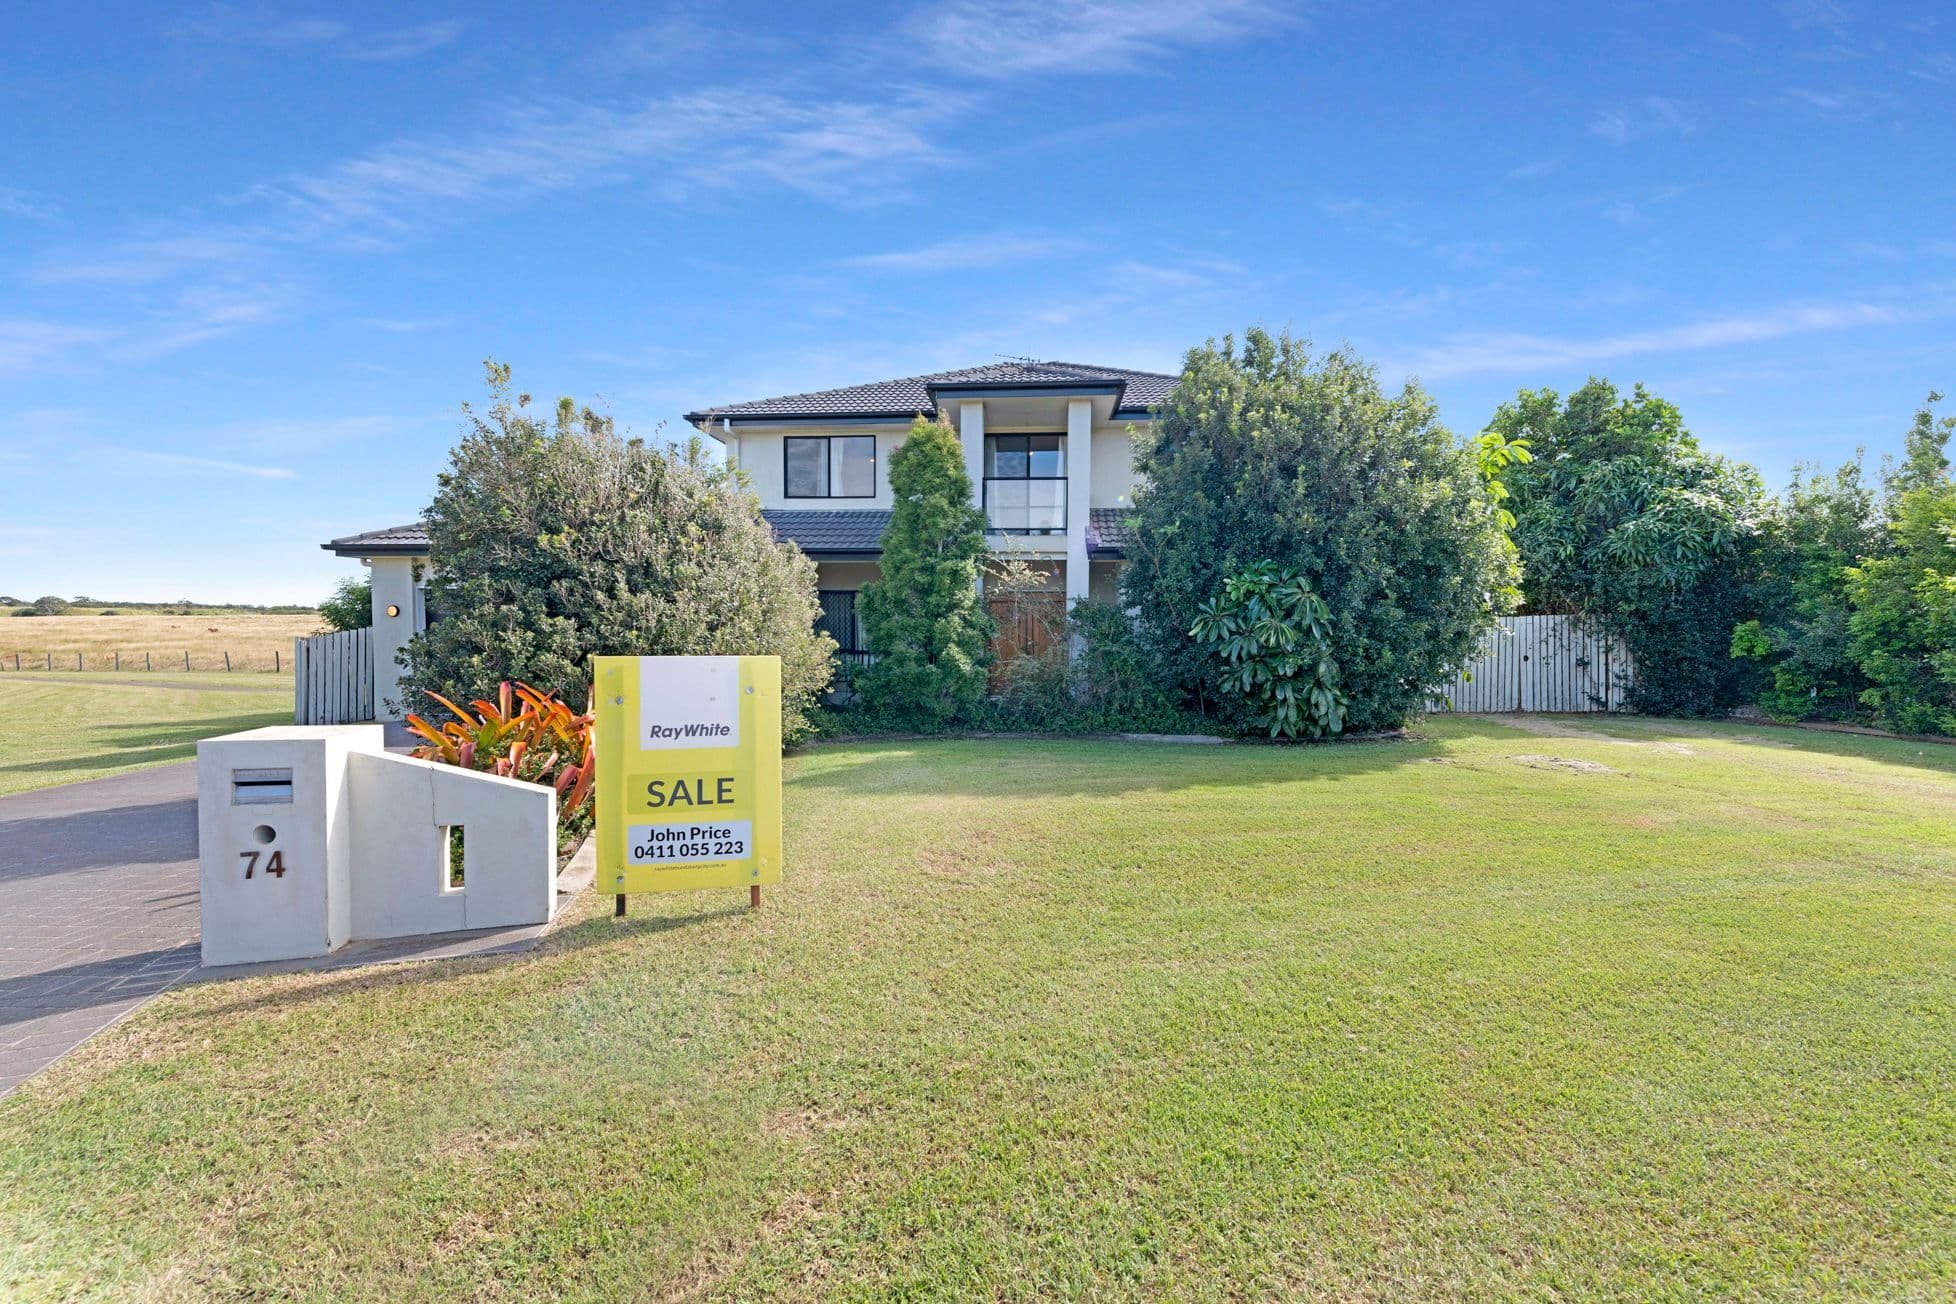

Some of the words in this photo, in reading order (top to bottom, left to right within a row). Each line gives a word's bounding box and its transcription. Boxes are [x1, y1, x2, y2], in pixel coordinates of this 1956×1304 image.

[646, 777, 735, 808] SALE
[647, 828, 686, 843] John
[690, 826, 731, 840] Price
[634, 844, 675, 859] 0411
[679, 843, 710, 857] 055
[714, 841, 744, 855] 223
[240, 851, 286, 880] 74
